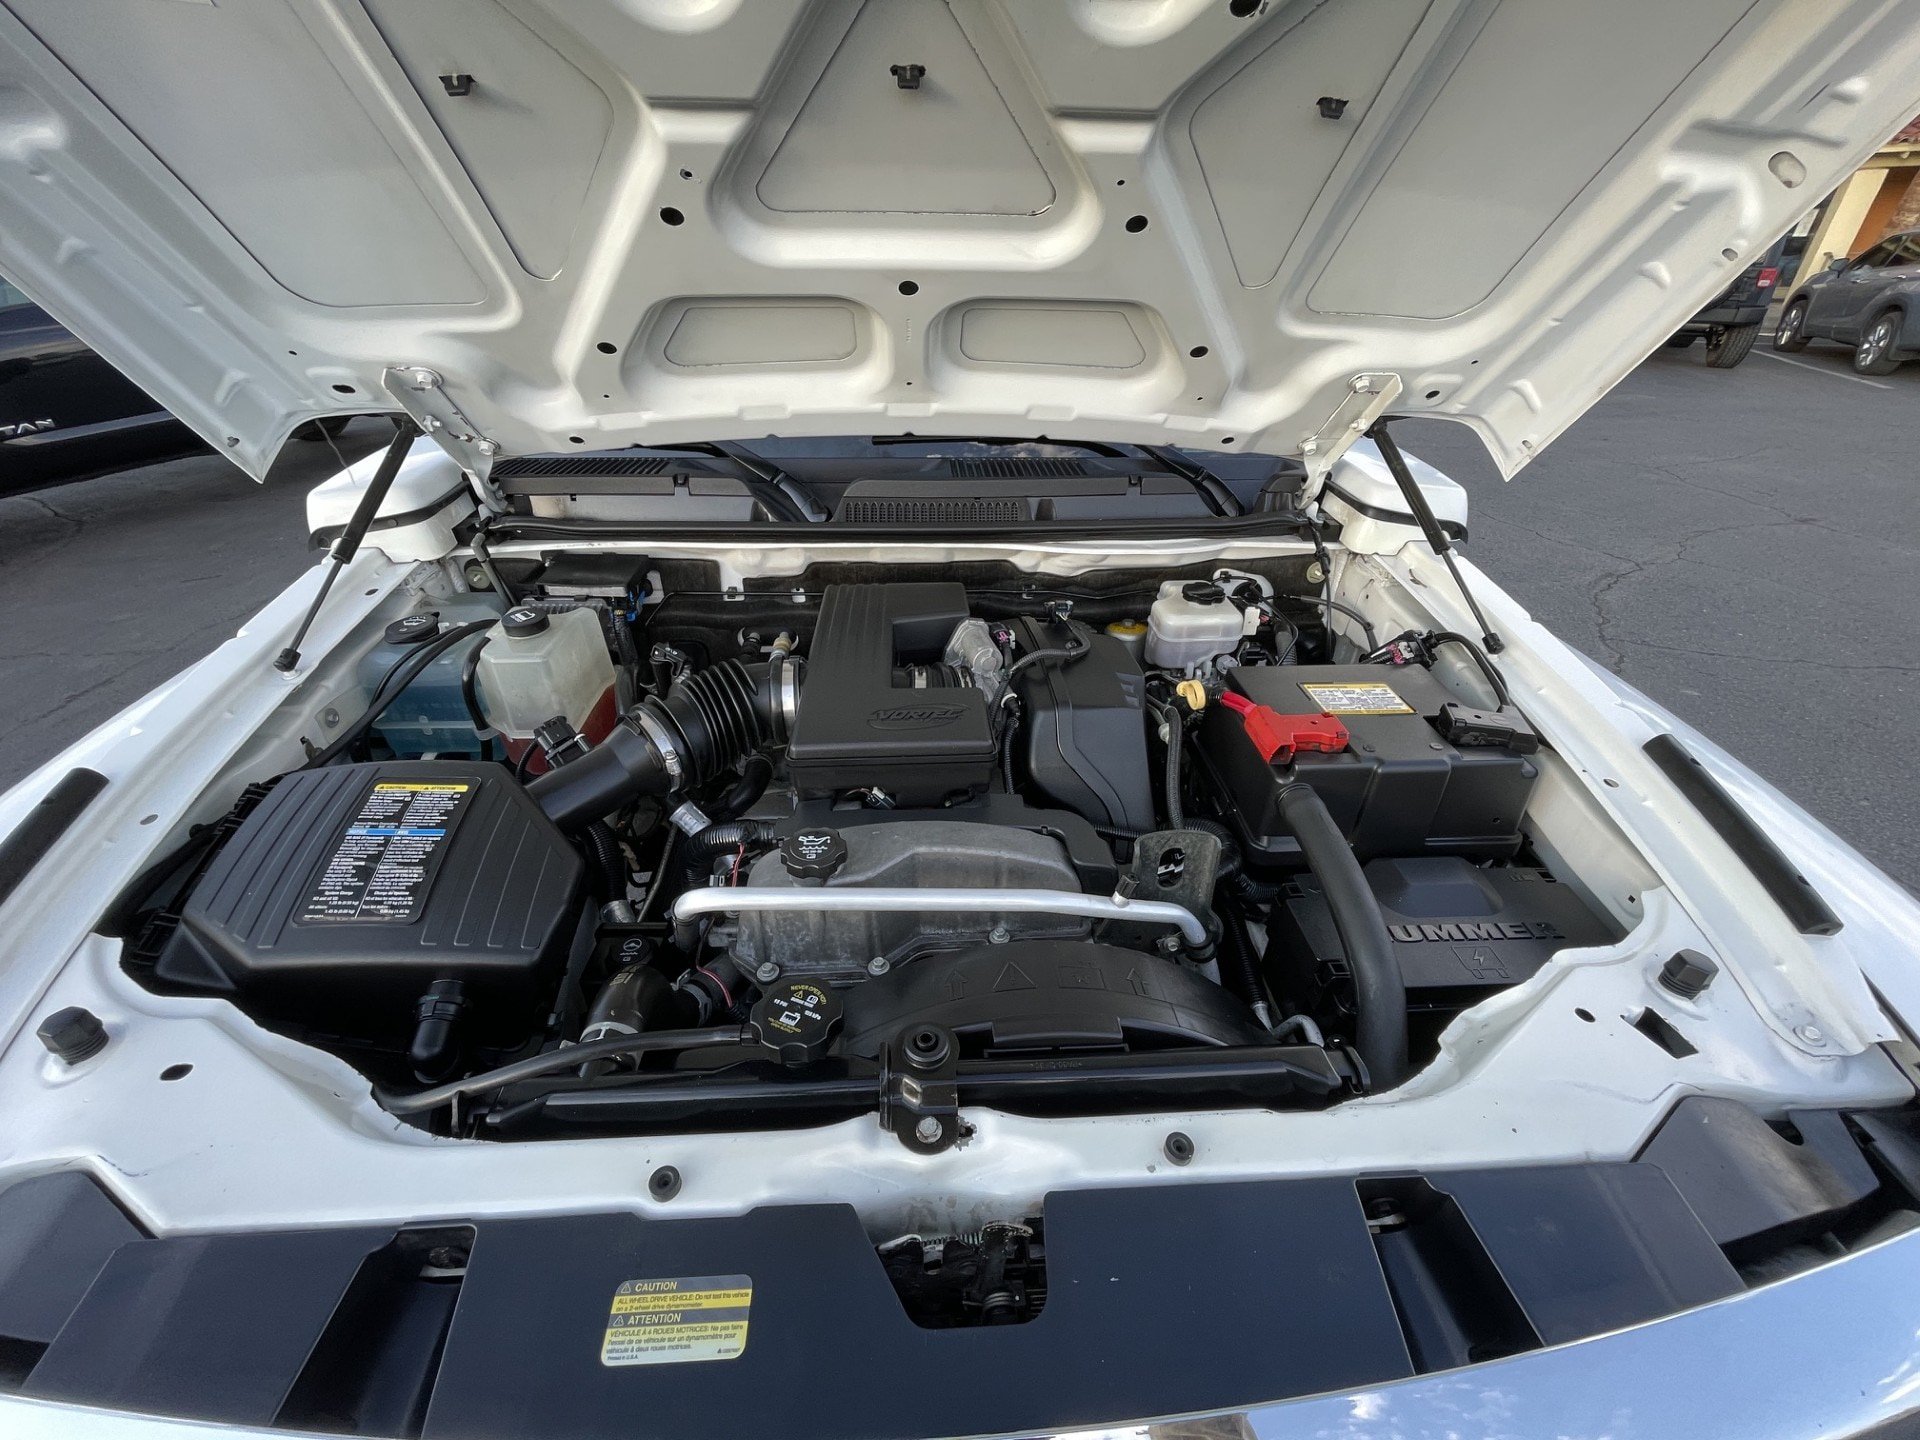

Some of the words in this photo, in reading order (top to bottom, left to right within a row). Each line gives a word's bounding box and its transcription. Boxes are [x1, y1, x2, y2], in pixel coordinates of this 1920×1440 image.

[1388, 921, 1566, 943] UMMER
[635, 1281, 678, 1292] CAUTION
[617, 1297, 628, 1305] ALL
[629, 1296, 649, 1304] WHEEL
[650, 1295, 668, 1303] DRIVE
[627, 1313, 682, 1326] ATTENTION
